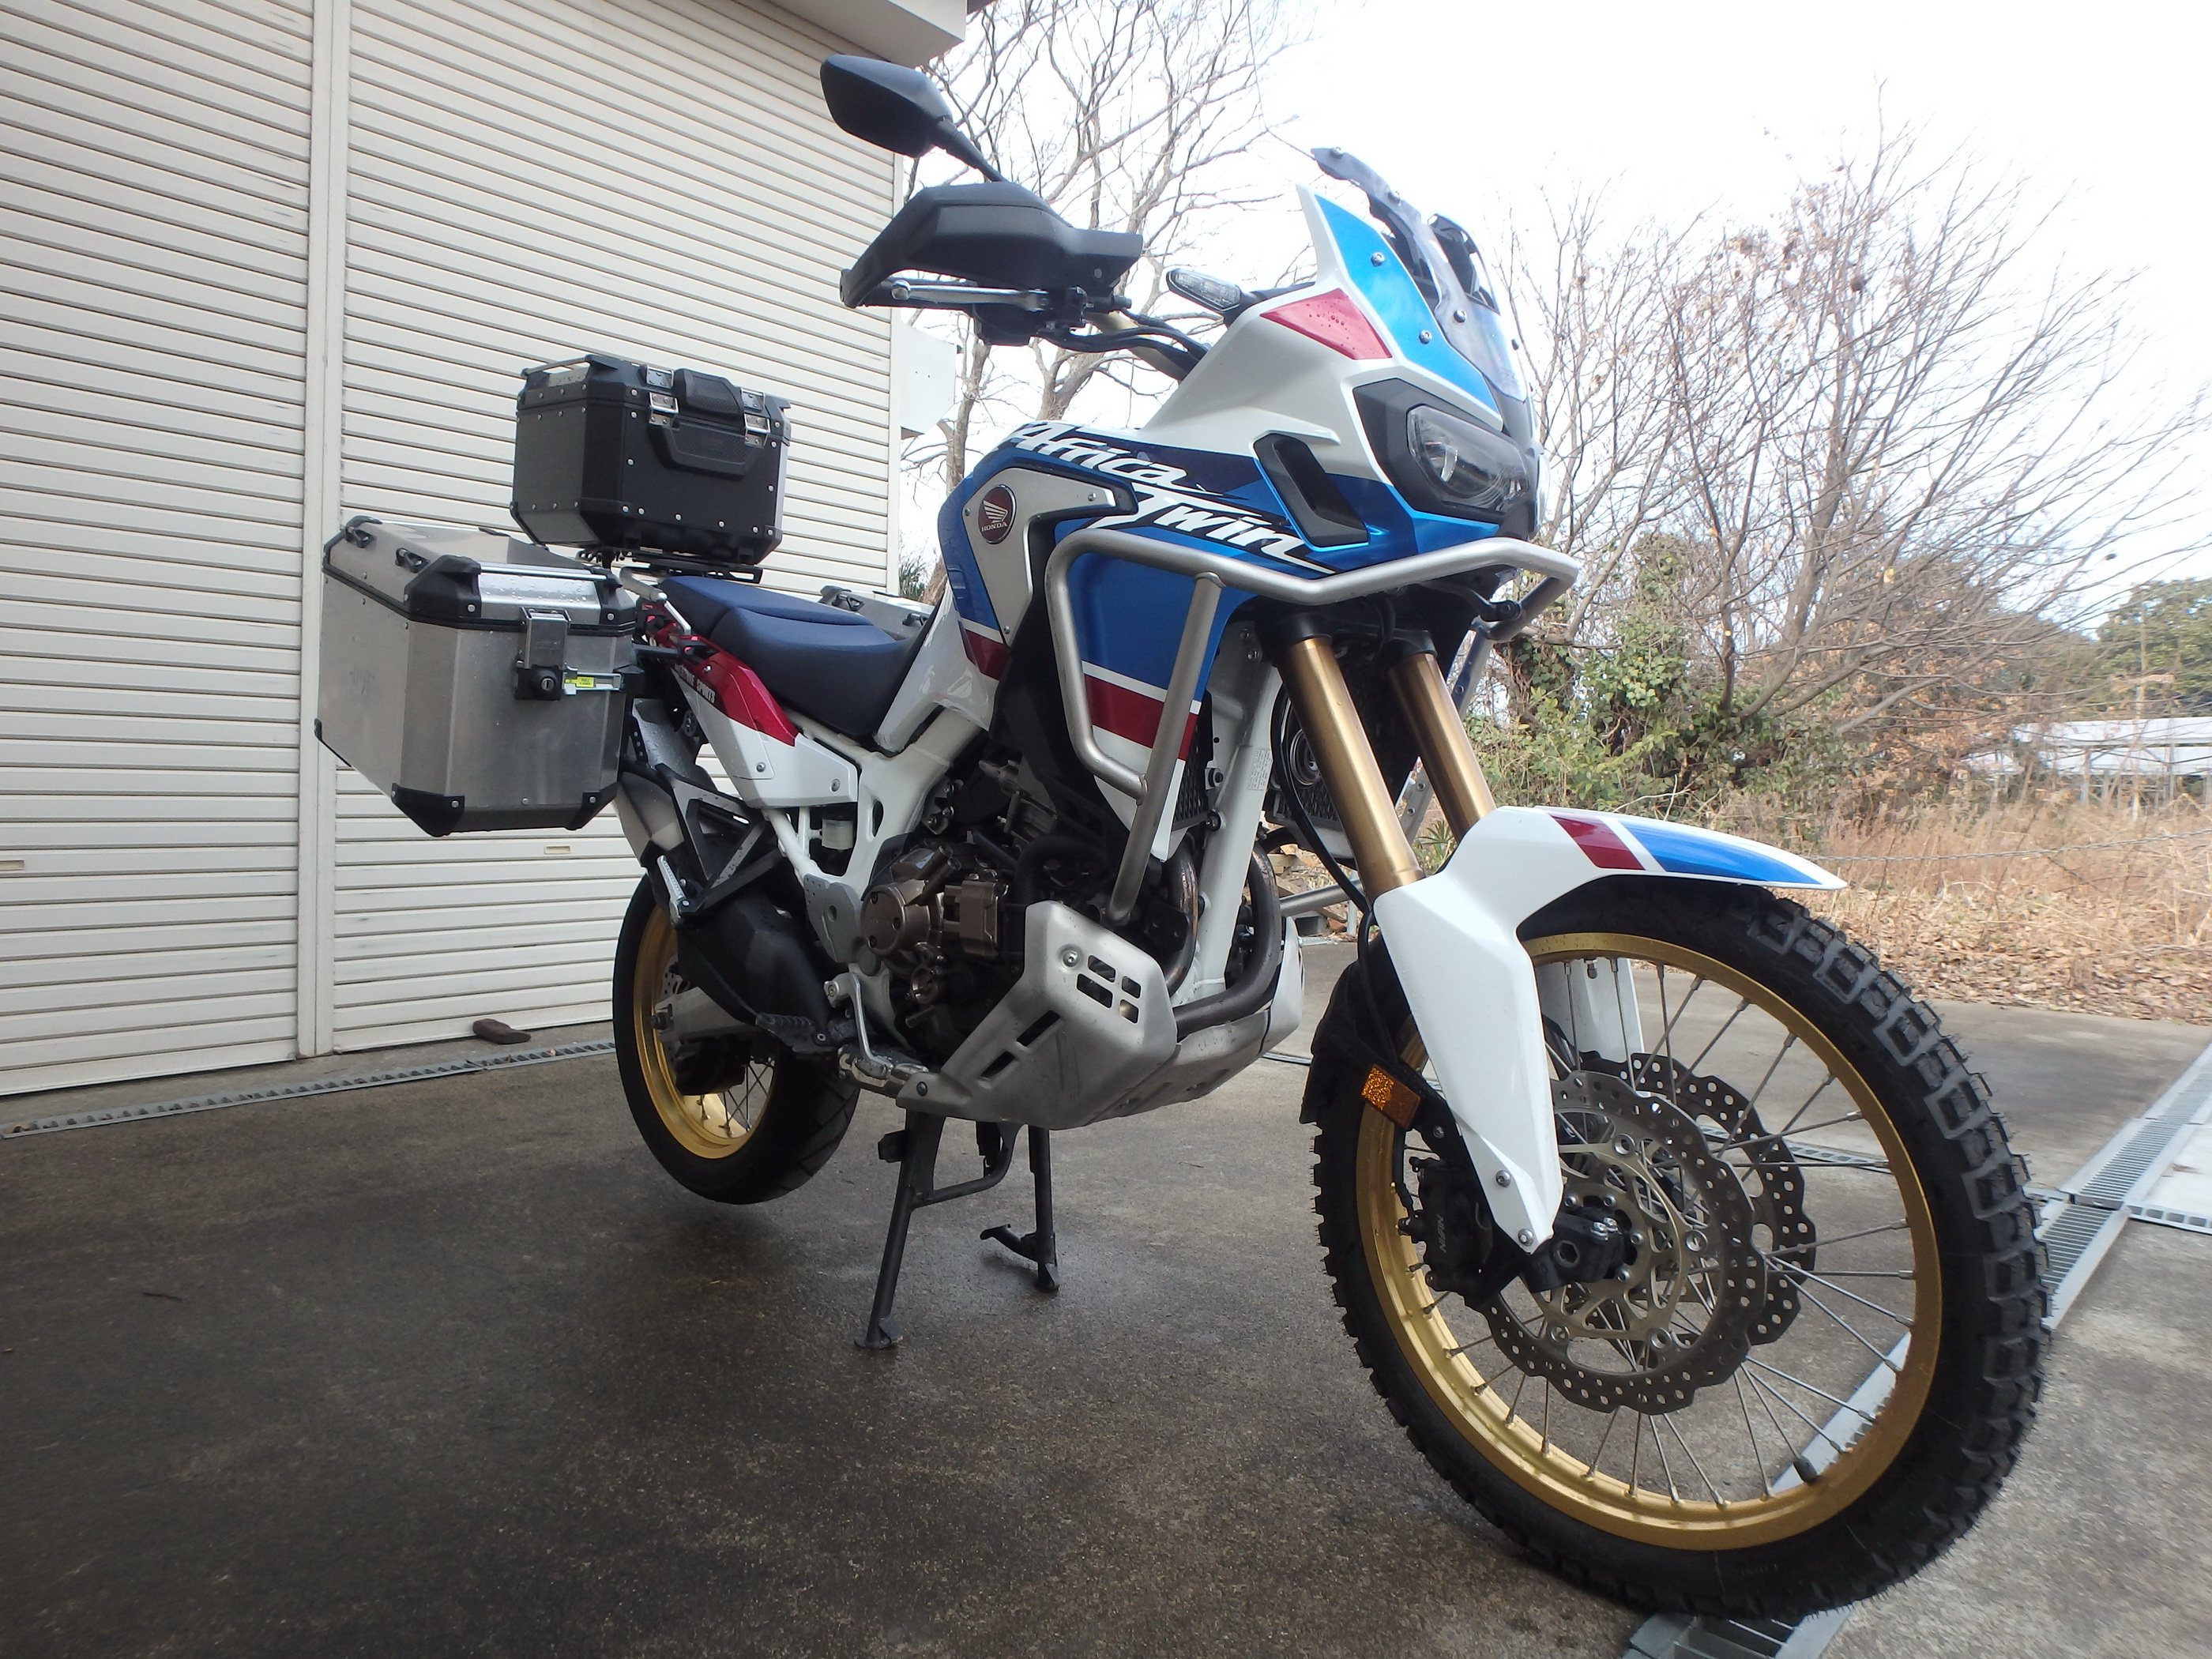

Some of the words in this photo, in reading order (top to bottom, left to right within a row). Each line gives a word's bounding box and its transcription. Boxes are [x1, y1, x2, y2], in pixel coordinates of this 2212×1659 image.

[994, 421, 1224, 496] Africa
[981, 521, 1008, 532] HONDA
[1086, 482, 1336, 574] Twin
[696, 679, 716, 703] SPORTS
